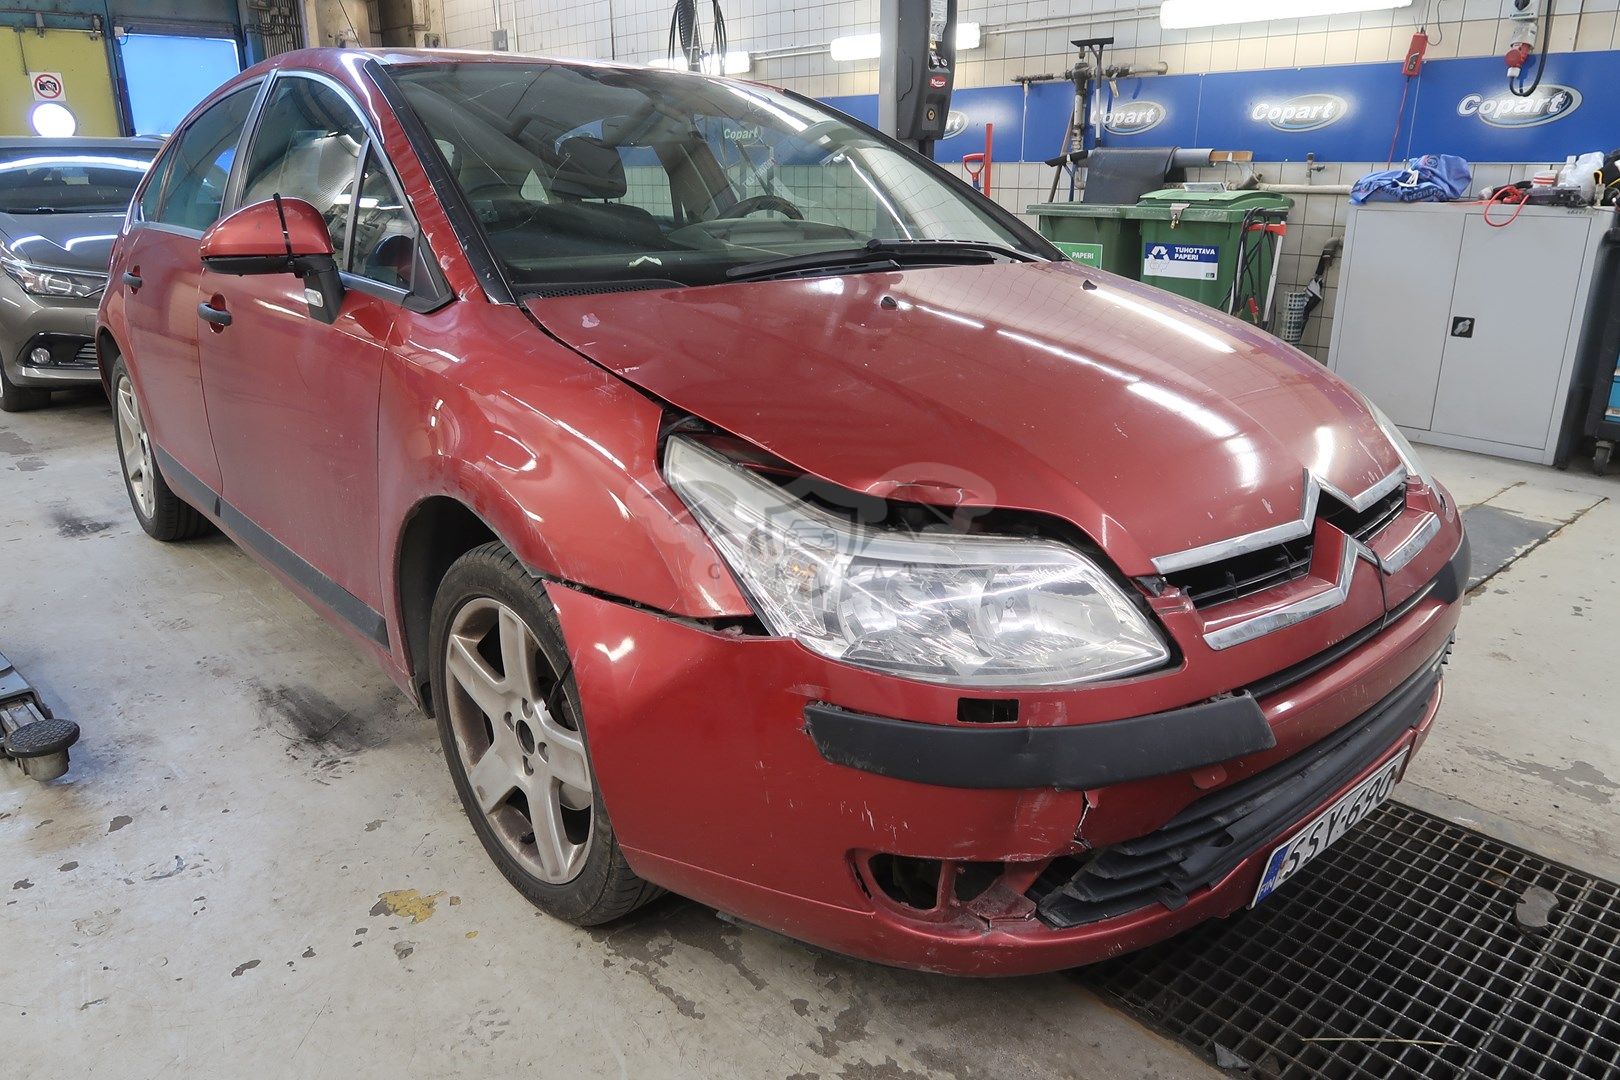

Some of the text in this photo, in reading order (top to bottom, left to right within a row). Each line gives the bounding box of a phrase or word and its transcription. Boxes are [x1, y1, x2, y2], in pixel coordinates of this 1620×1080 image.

[1457, 90, 1567, 118] Copart
[1252, 100, 1335, 124] Copart
[724, 126, 758, 141] Copart
[1071, 251, 1094, 259] PAPERI
[1174, 246, 1215, 255] TUHOTTAVA
[1174, 253, 1199, 261] PAPERI
[1281, 764, 1397, 880] SSY-690
